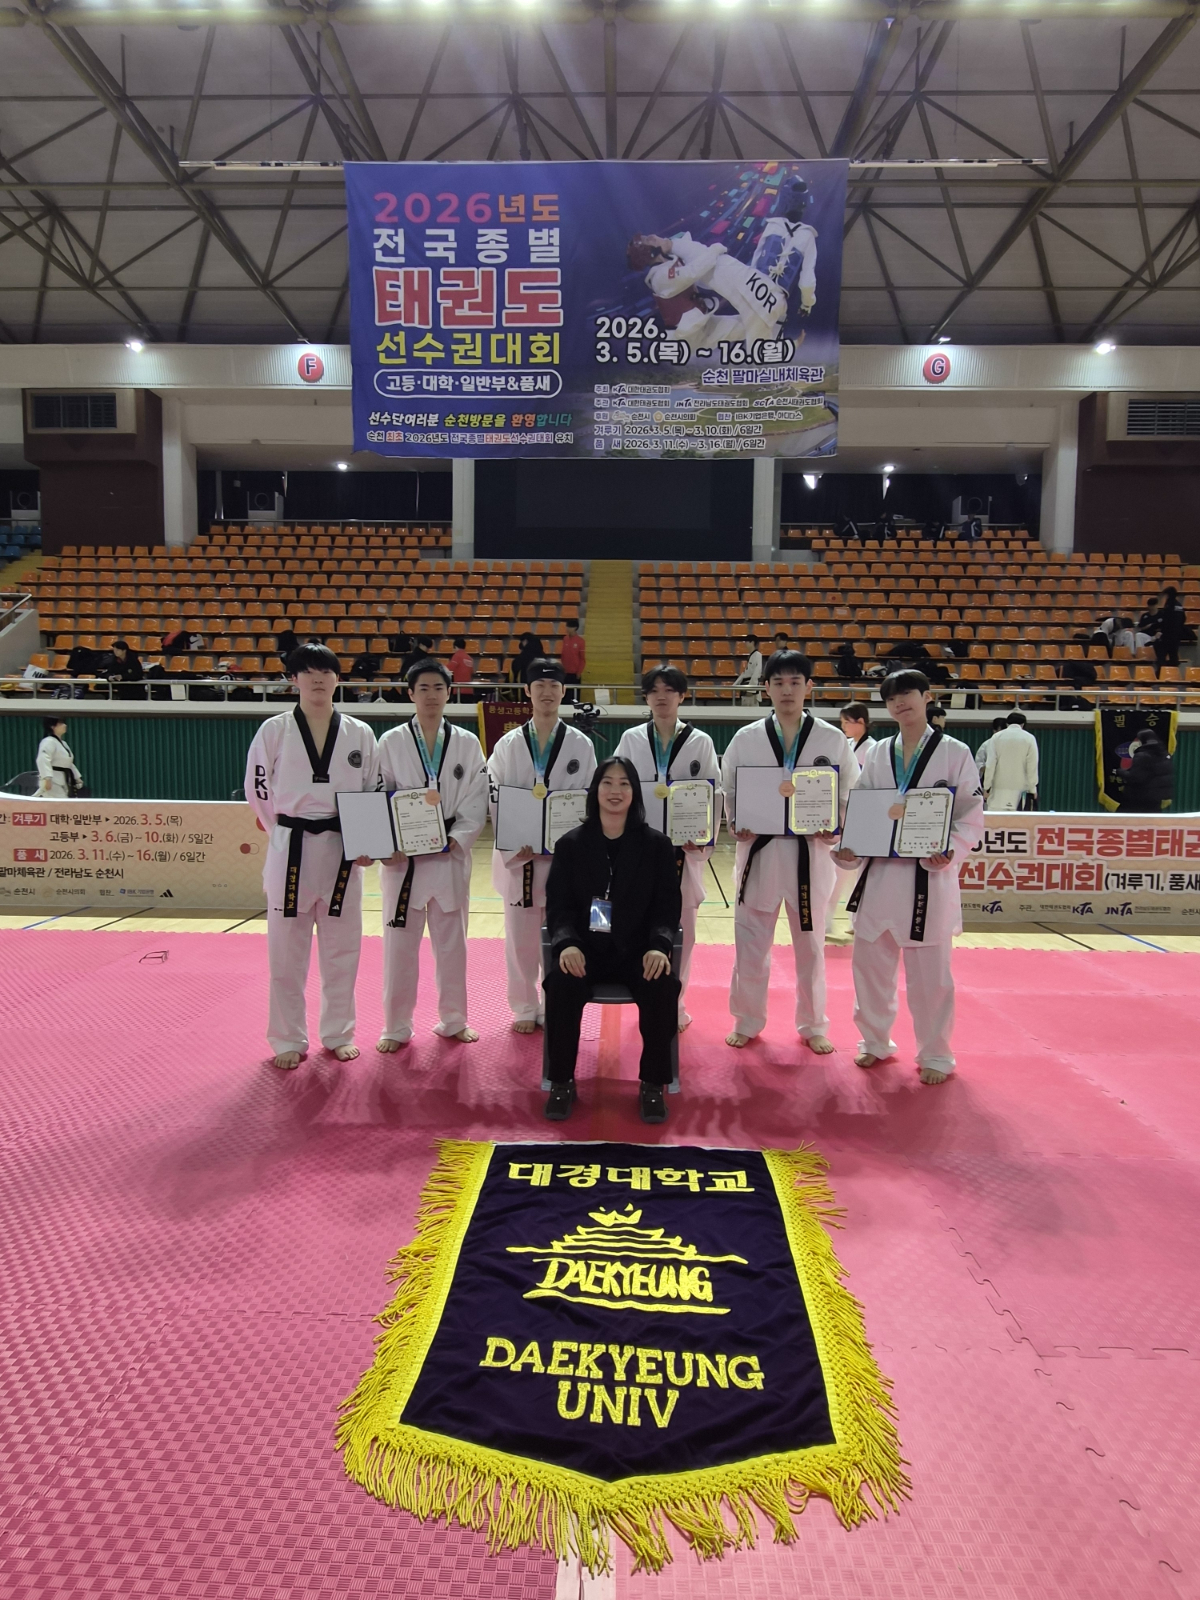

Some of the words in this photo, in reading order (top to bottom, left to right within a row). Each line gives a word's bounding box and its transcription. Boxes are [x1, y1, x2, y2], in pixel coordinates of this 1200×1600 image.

[373, 192, 560, 223] 2026년도
[373, 227, 560, 264] 전국종별
[373, 266, 563, 328] 태권도
[746, 272, 777, 313] KOR
[596, 317, 667, 339] 2026.
[376, 331, 560, 365] 선수권대회
[595, 341, 618, 363] 3.
[627, 341, 689, 364] 5.(목)
[719, 340, 794, 364] 16.(월)
[305, 357, 317, 375] F
[931, 357, 945, 376] G
[386, 375, 551, 391] 고등·대학·일반부&품새
[702, 369, 729, 384] 순천
[732, 367, 823, 384] 팔마실내체육관
[612, 384, 626, 394] KTA
[612, 398, 626, 407] KTA
[675, 398, 692, 407] JNTA
[368, 411, 439, 427] 선수단여러분
[444, 413, 506, 427] 순천방문을
[511, 413, 572, 428] 환영합니다
[367, 431, 384, 442] 순천
[386, 431, 403, 442] 최초
[405, 433, 449, 443] 2026년도
[555, 432, 573, 443] 유치
[594, 425, 621, 435] 겨루기
[625, 426, 651, 435] 2026.
[625, 440, 651, 449] 2026.
[255, 764, 268, 801] DKU
[13, 813, 45, 826] 겨루기
[50, 814, 102, 826] 대학·일반부
[113, 815, 139, 825] 2026.
[140, 813, 152, 826] 3.
[50, 831, 79, 843] 고등부
[91, 830, 103, 842] 3.
[105, 830, 133, 843] 6.(금)
[144, 831, 179, 844] 10.(화)
[188, 833, 214, 845] 5일간
[50, 850, 75, 860] 2026.
[77, 849, 89, 861] 3.
[92, 849, 125, 861] 11.(수)
[136, 849, 171, 862] 16.(월)
[179, 851, 206, 863] 6일간
[54, 867, 94, 879] 전라남도
[95, 867, 124, 879] 순천시
[13, 888, 36, 896] 순천시
[981, 900, 1003, 914] KTA
[1072, 902, 1094, 915] KTA
[1104, 902, 1133, 916] JNTA
[508, 1162, 755, 1192] 대경대학교
[533, 1258, 713, 1302] DAEKYEUNG
[479, 1337, 765, 1390] DAEKYEUNG
[557, 1380, 680, 1428] UNIV
